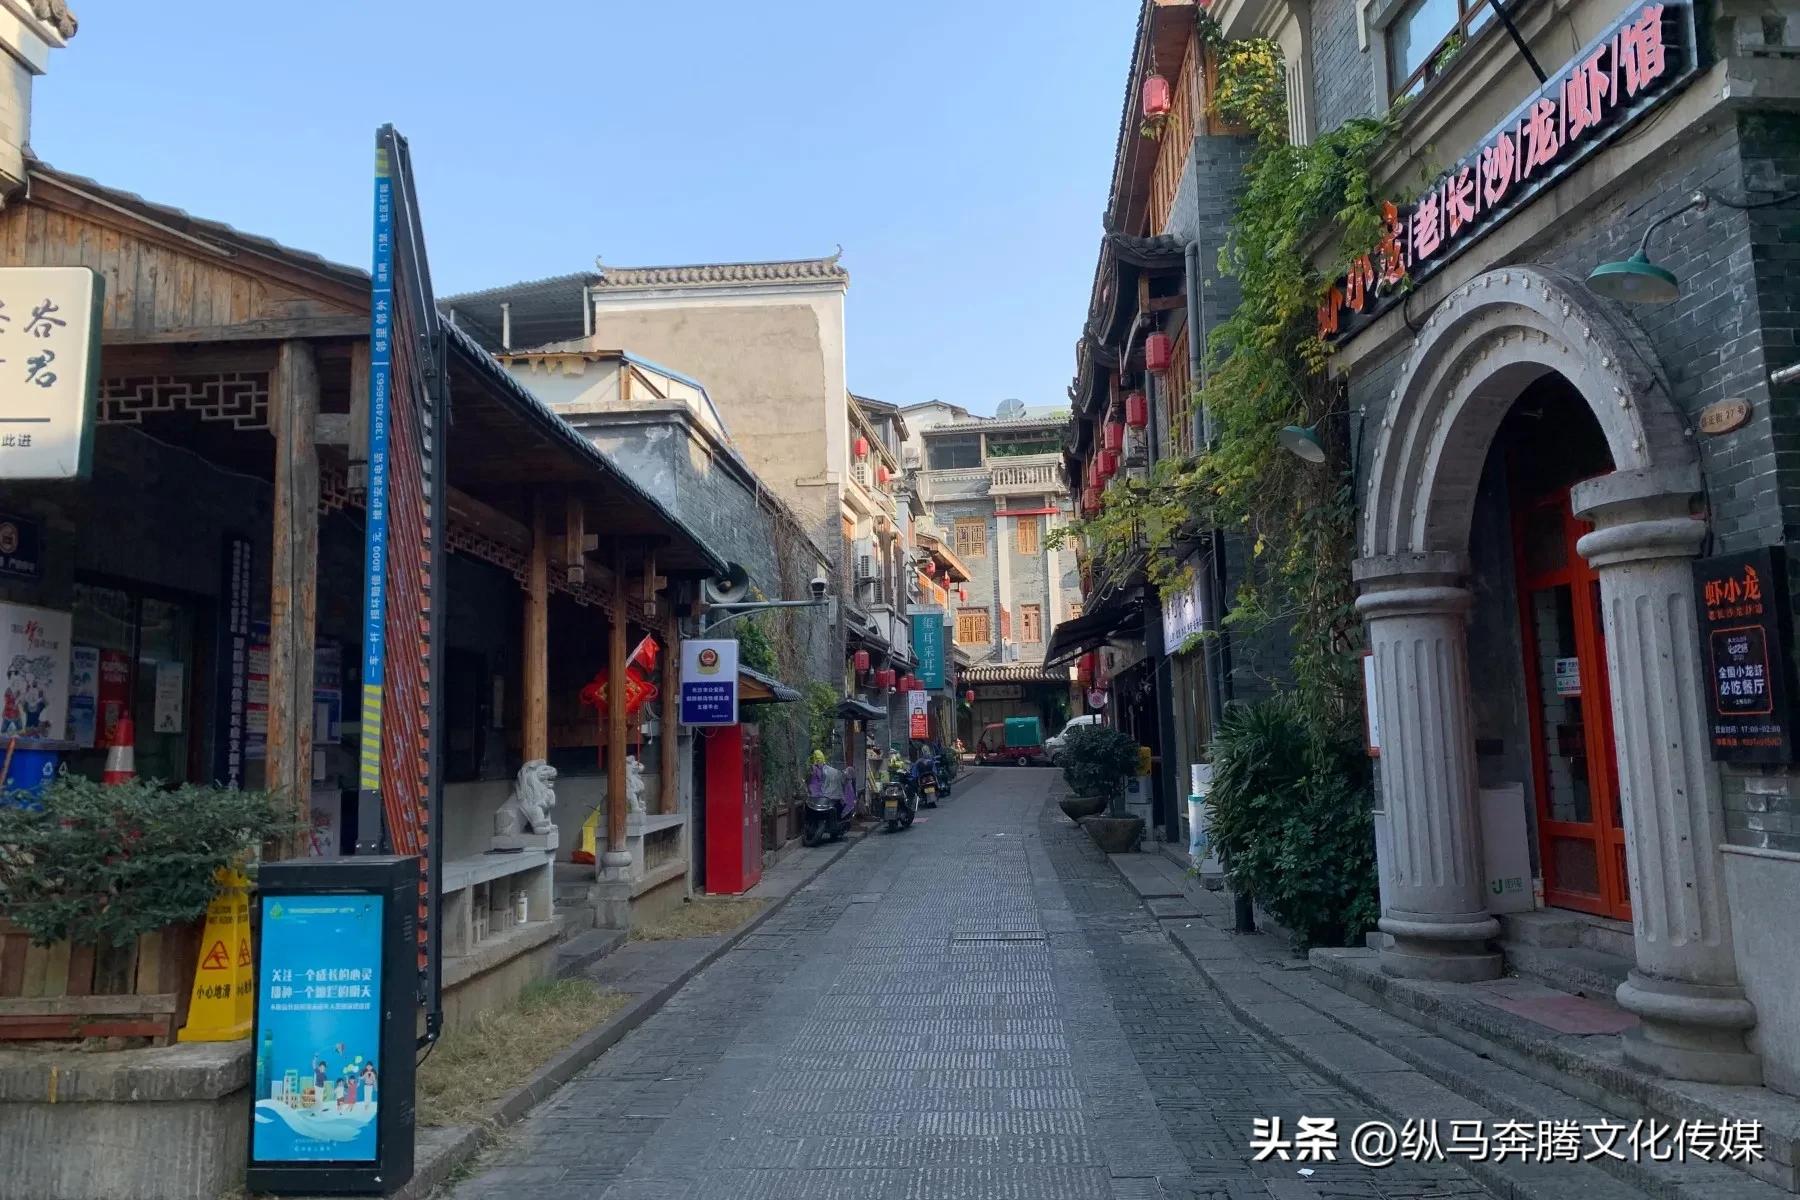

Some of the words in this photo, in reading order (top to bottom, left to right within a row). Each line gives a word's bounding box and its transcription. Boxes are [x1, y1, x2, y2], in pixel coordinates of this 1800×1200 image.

[375, 299, 388, 352] 邻里邻外
[1704, 564, 1762, 606] 虾小龙
[1718, 664, 1764, 679] 全国小龙虾
[1720, 679, 1765, 696] 必吃餐厅
[272, 968, 373, 982] 关注一个成长的心灵
[197, 984, 231, 1000] 小心地滑
